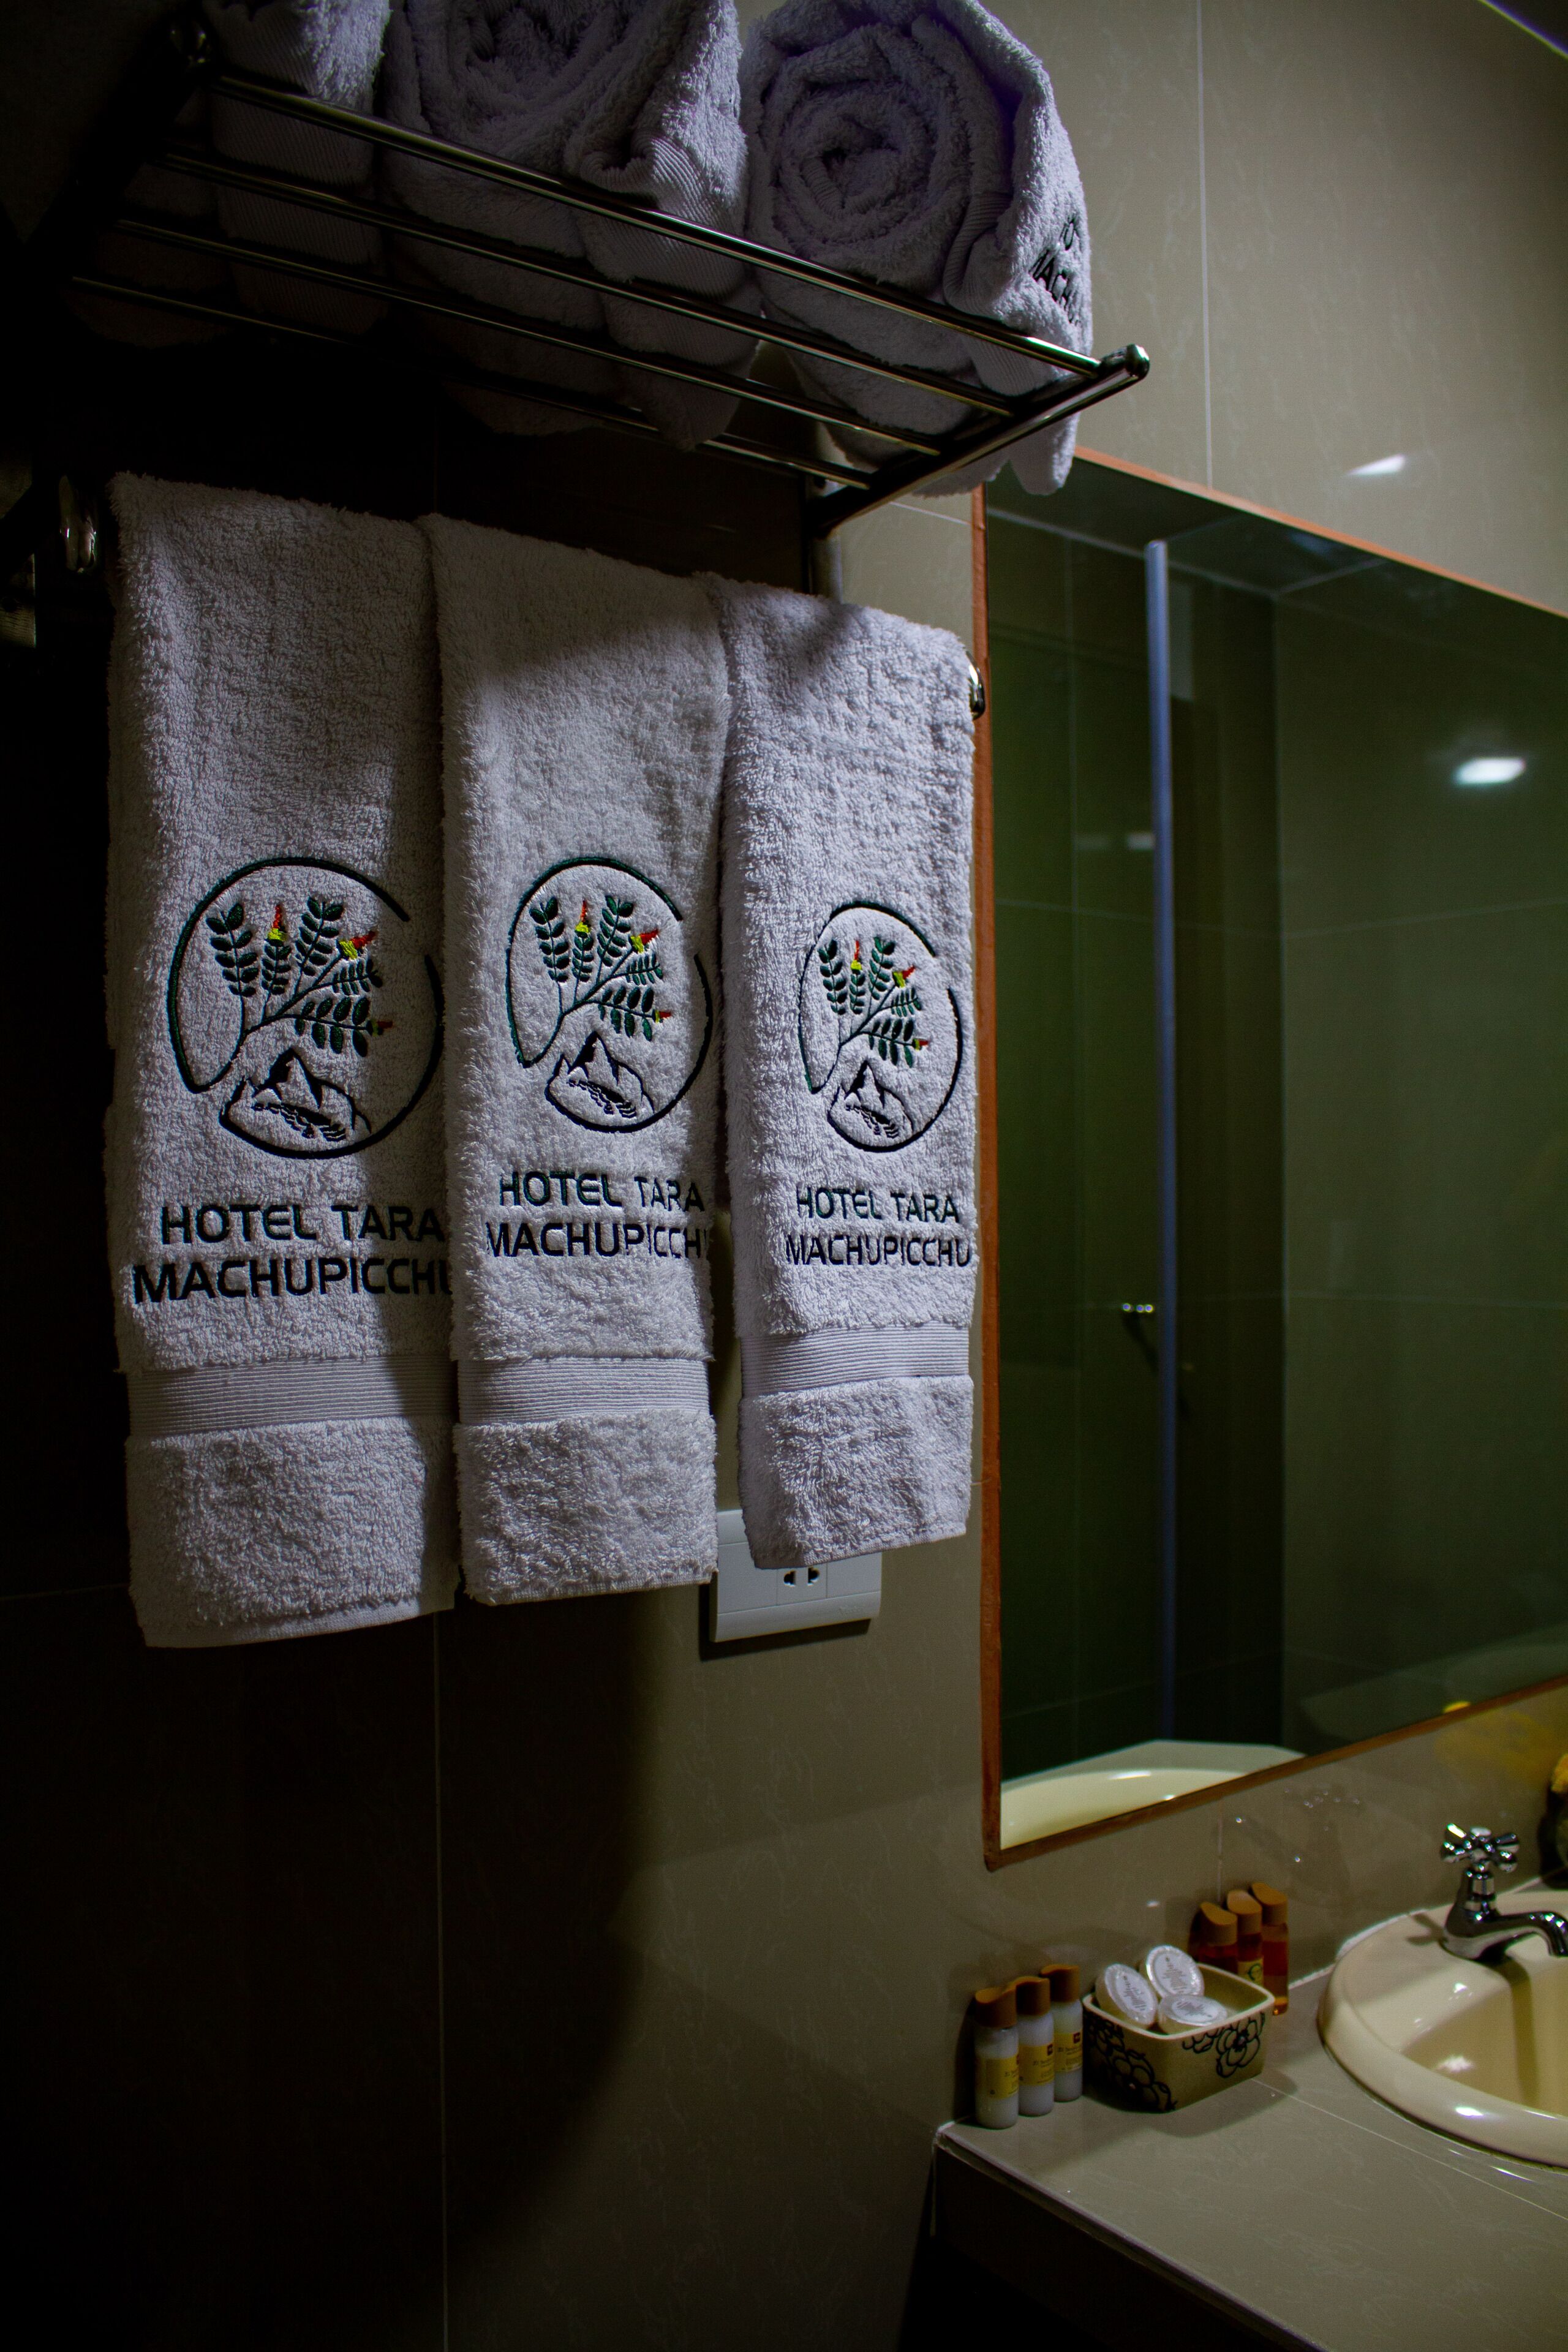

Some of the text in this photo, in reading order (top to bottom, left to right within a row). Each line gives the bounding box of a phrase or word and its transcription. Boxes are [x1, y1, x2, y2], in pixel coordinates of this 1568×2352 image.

[499, 1171, 704, 1212] HOTEL TARA
[797, 1187, 959, 1223] HOTEL TARA
[161, 1204, 445, 1245] HOTEL TARA
[486, 1222, 707, 1258] MACHUPICCH
[786, 1234, 970, 1267] MACHUPICCHU
